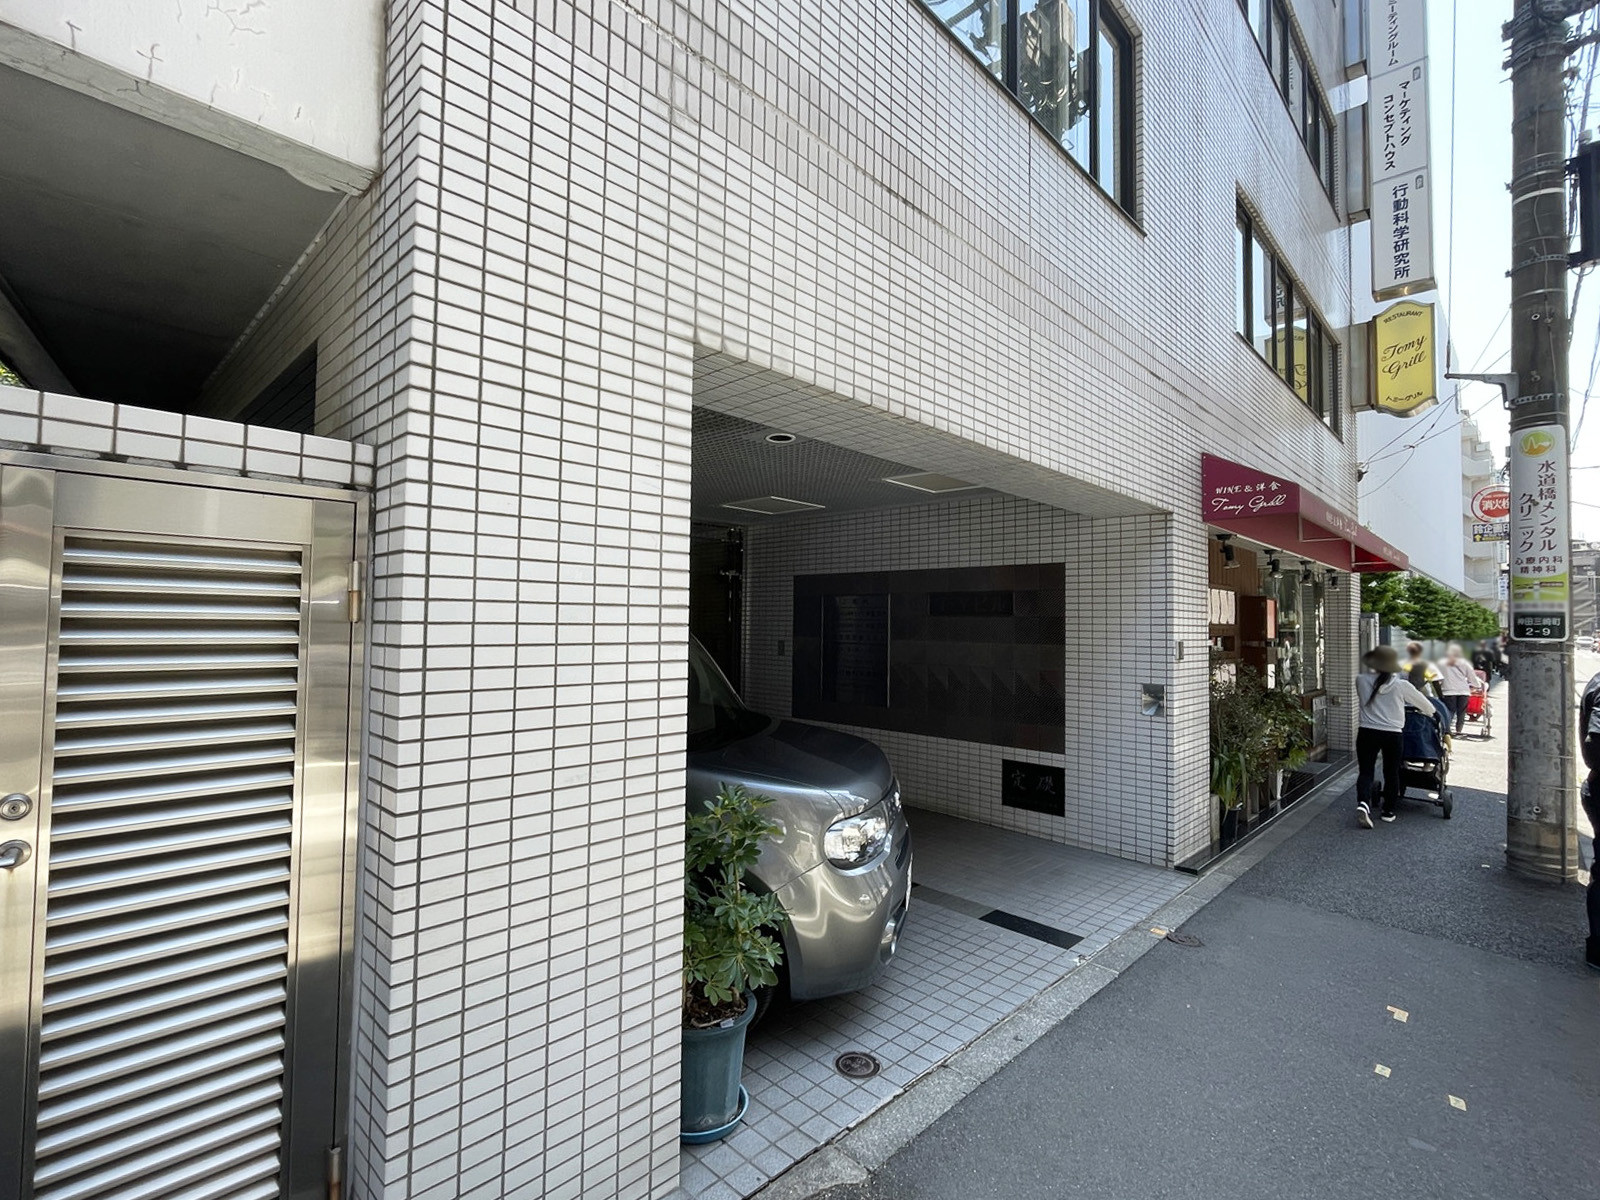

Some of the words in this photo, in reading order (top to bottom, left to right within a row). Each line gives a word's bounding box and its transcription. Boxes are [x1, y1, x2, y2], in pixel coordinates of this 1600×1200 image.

[1399, 80, 1412, 146] マーケティング
[1384, 94, 1396, 171] コンセプトハウス
[1392, 182, 1410, 280] 行動科学研究所
[1383, 310, 1423, 324] RESTAURANT
[1381, 335, 1427, 362] Tomy
[1382, 351, 1427, 380] Grill
[1215, 485, 1242, 494] WINE
[1244, 485, 1253, 493] &
[1248, 494, 1287, 513] Grill
[1537, 460, 1557, 552] 水道橋メンタル
[1519, 492, 1534, 554] クリニック
[1514, 555, 1563, 566] 心療内科
[1520, 565, 1556, 574] 精神科
[1525, 627, 1551, 636] 2-9
